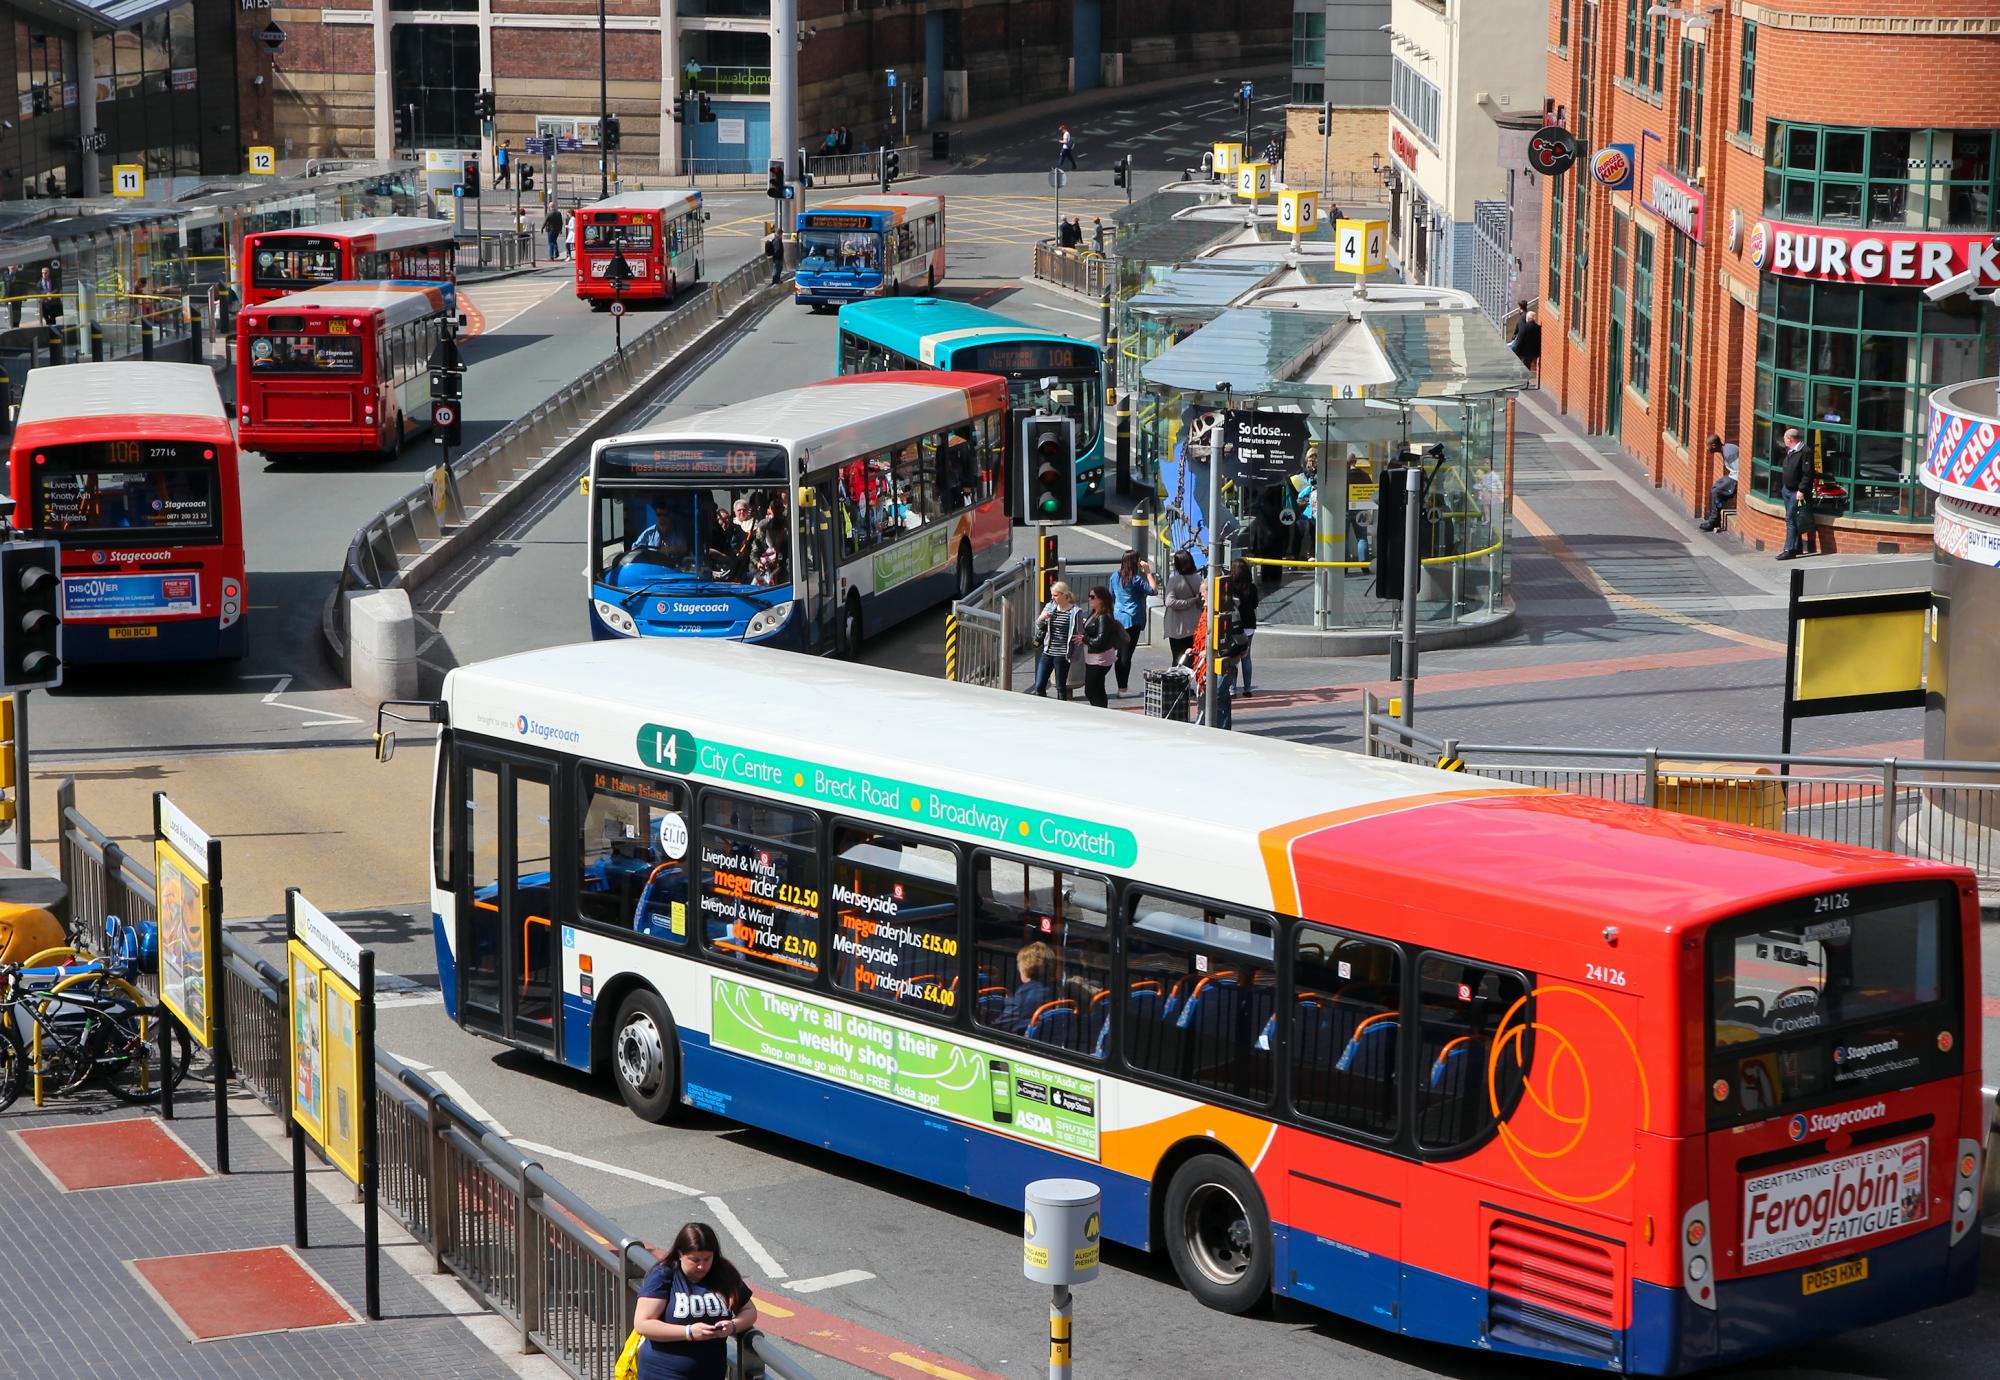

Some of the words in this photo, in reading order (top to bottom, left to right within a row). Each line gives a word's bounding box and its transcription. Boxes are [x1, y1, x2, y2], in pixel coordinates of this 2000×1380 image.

[254, 155, 269, 167] 12
[1219, 153, 1224, 162] 1
[1233, 152, 1238, 161] 1
[1597, 153, 1622, 173] BURGER
[1259, 173, 1266, 189] 2
[1600, 158, 1625, 181] KING
[121, 175, 136, 188] 11
[1243, 174, 1250, 189] 2
[1284, 202, 1291, 221] 3
[1303, 203, 1311, 222] 3
[1345, 236, 1355, 259] 4
[1370, 235, 1379, 259] 4
[1774, 231, 1953, 282] BURGER
[1049, 349, 1073, 367] 10A
[438, 412, 451, 421] 10
[1239, 422, 1251, 435] So
[108, 440, 141, 463] 10A
[150, 449, 176, 458] 27716
[1265, 439, 1281, 447] away
[1934, 416, 1964, 478] ECHO
[1952, 422, 1996, 486] ECHO
[724, 449, 757, 476] 10A
[50, 492, 76, 501] Knotty
[51, 503, 79, 511] Prescot
[164, 500, 207, 510] Stagecoach
[61, 514, 87, 522] Helens
[1968, 531, 1981, 546] BUY
[1981, 534, 1989, 547] IT
[109, 550, 172, 564] Stagecoach
[68, 580, 119, 596] DISCOVER
[672, 601, 730, 615] Stagecoach
[133, 628, 151, 636] BCU
[678, 624, 702, 633] 27708
[529, 719, 580, 744] Stagecoach
[611, 776, 636, 794] Mann
[639, 783, 670, 801] Island
[656, 731, 678, 767] 14
[699, 744, 729, 778] City
[732, 751, 783, 785] Centre
[815, 771, 856, 801] Breck
[860, 779, 900, 809] Road
[929, 795, 1009, 837] Broadway
[1039, 818, 1116, 859] Croxteth
[662, 826, 686, 846] £1.10
[701, 846, 739, 870] Liverpool
[739, 855, 748, 871] &
[713, 869, 778, 899] megarider
[778, 884, 819, 909] £12.50
[832, 884, 898, 916] Merseyside
[701, 894, 737, 917] Liverpool
[738, 904, 747, 920] &
[748, 906, 775, 927] Wirral
[1814, 893, 1850, 913] 24126
[731, 918, 783, 949] dayrider
[784, 935, 817, 959] £3.70
[843, 914, 922, 949] megariderplus
[922, 933, 958, 957] £15.00
[832, 933, 899, 967] Merseyside
[854, 963, 923, 999] dayriderplus
[923, 984, 955, 1007] £4.00
[1585, 962, 1627, 987] 24126
[761, 991, 820, 1026] They're
[823, 1011, 842, 1032] all
[846, 1015, 894, 1050] doing
[897, 1031, 939, 1060] their
[1773, 1010, 1821, 1033] Croxteth
[798, 1029, 854, 1062] weekly
[857, 1044, 899, 1075] shop
[1846, 1039, 1899, 1060] Stagecoach
[760, 1042, 783, 1060] Shop
[785, 1051, 796, 1062] on
[797, 1052, 813, 1067] the
[814, 1060, 827, 1072] go
[828, 1062, 848, 1078] with
[849, 1067, 864, 1083] the
[866, 1074, 891, 1091] FREE
[893, 1082, 916, 1099] Asda
[918, 1090, 941, 1107] app!
[1014, 1063, 1041, 1079] Search
[1041, 1071, 1053, 1081] for
[1015, 1109, 1054, 1137] ASDA
[1809, 1101, 1886, 1133] Stagecoach
[1747, 1175, 1785, 1194] GREAT
[1785, 1164, 1831, 1185] TASTING
[1832, 1154, 1873, 1174] GENTLE
[1874, 1146, 1902, 1164] IRON
[1746, 1163, 1900, 1240] Feroglobin
[1746, 1237, 1813, 1264] REDUCTION
[1826, 1206, 1900, 1243] FATIGUE
[1034, 1250, 1047, 1259] AND
[1806, 1268, 1836, 1291] PO59
[1839, 1261, 1863, 1282] HXR
